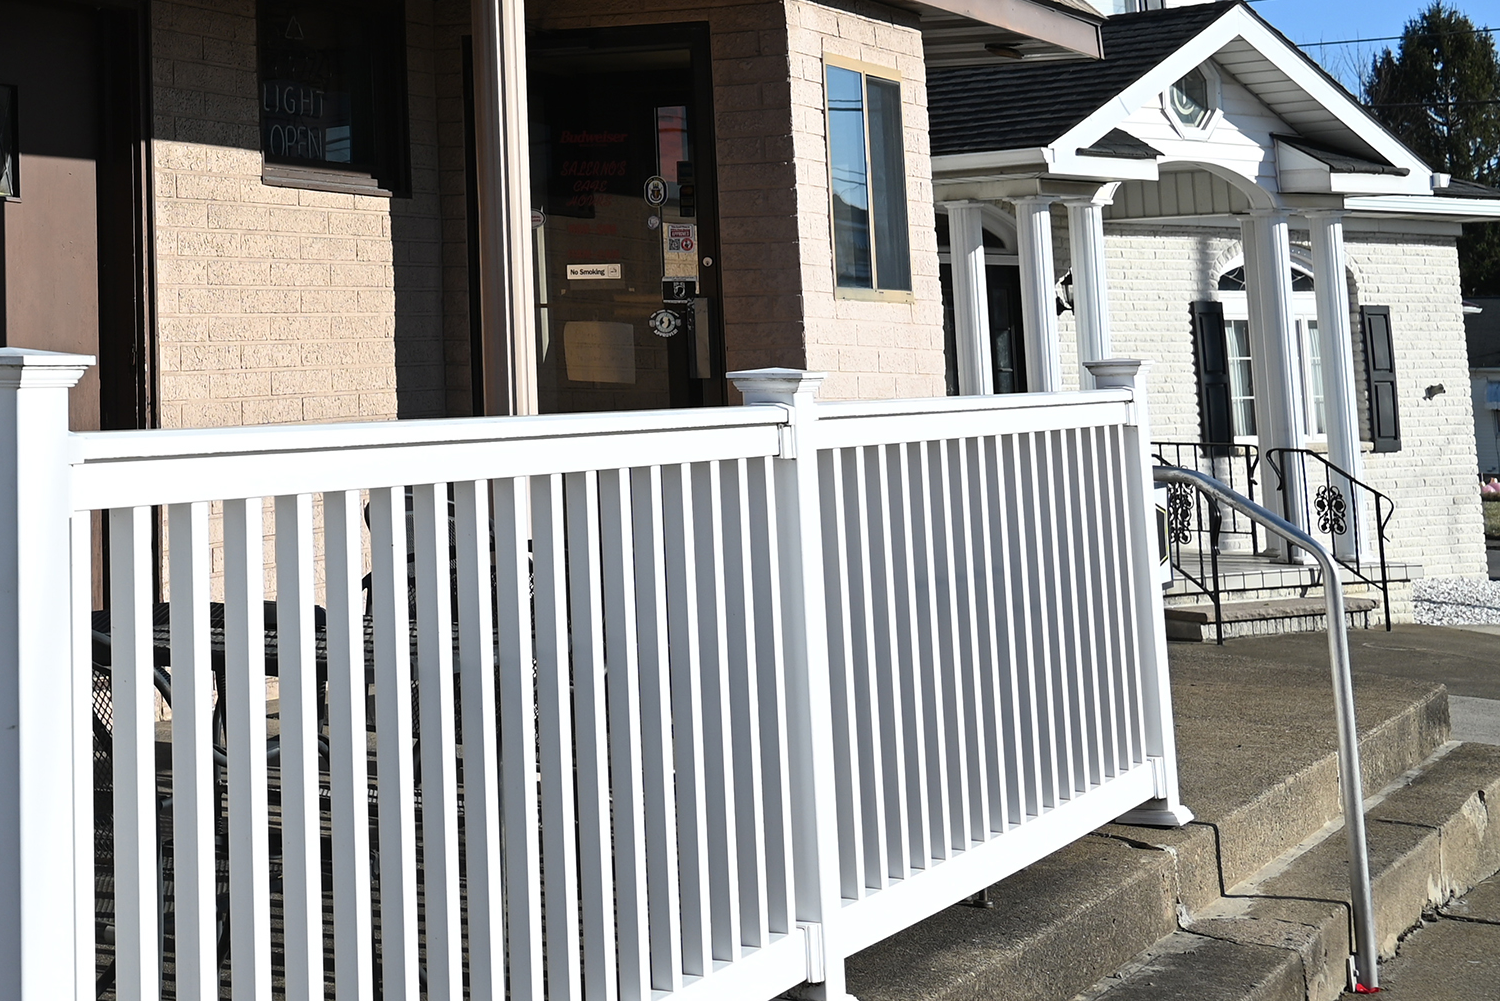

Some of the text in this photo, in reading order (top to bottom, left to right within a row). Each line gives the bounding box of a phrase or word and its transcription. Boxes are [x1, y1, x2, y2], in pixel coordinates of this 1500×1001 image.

[263, 83, 325, 118] LIGHT
[270, 124, 324, 160] OPEN
[559, 130, 629, 144] Budweiser
[560, 160, 628, 176] SALERNO'S
[573, 180, 609, 193] CAFE
[569, 268, 605, 277] No Smoking
